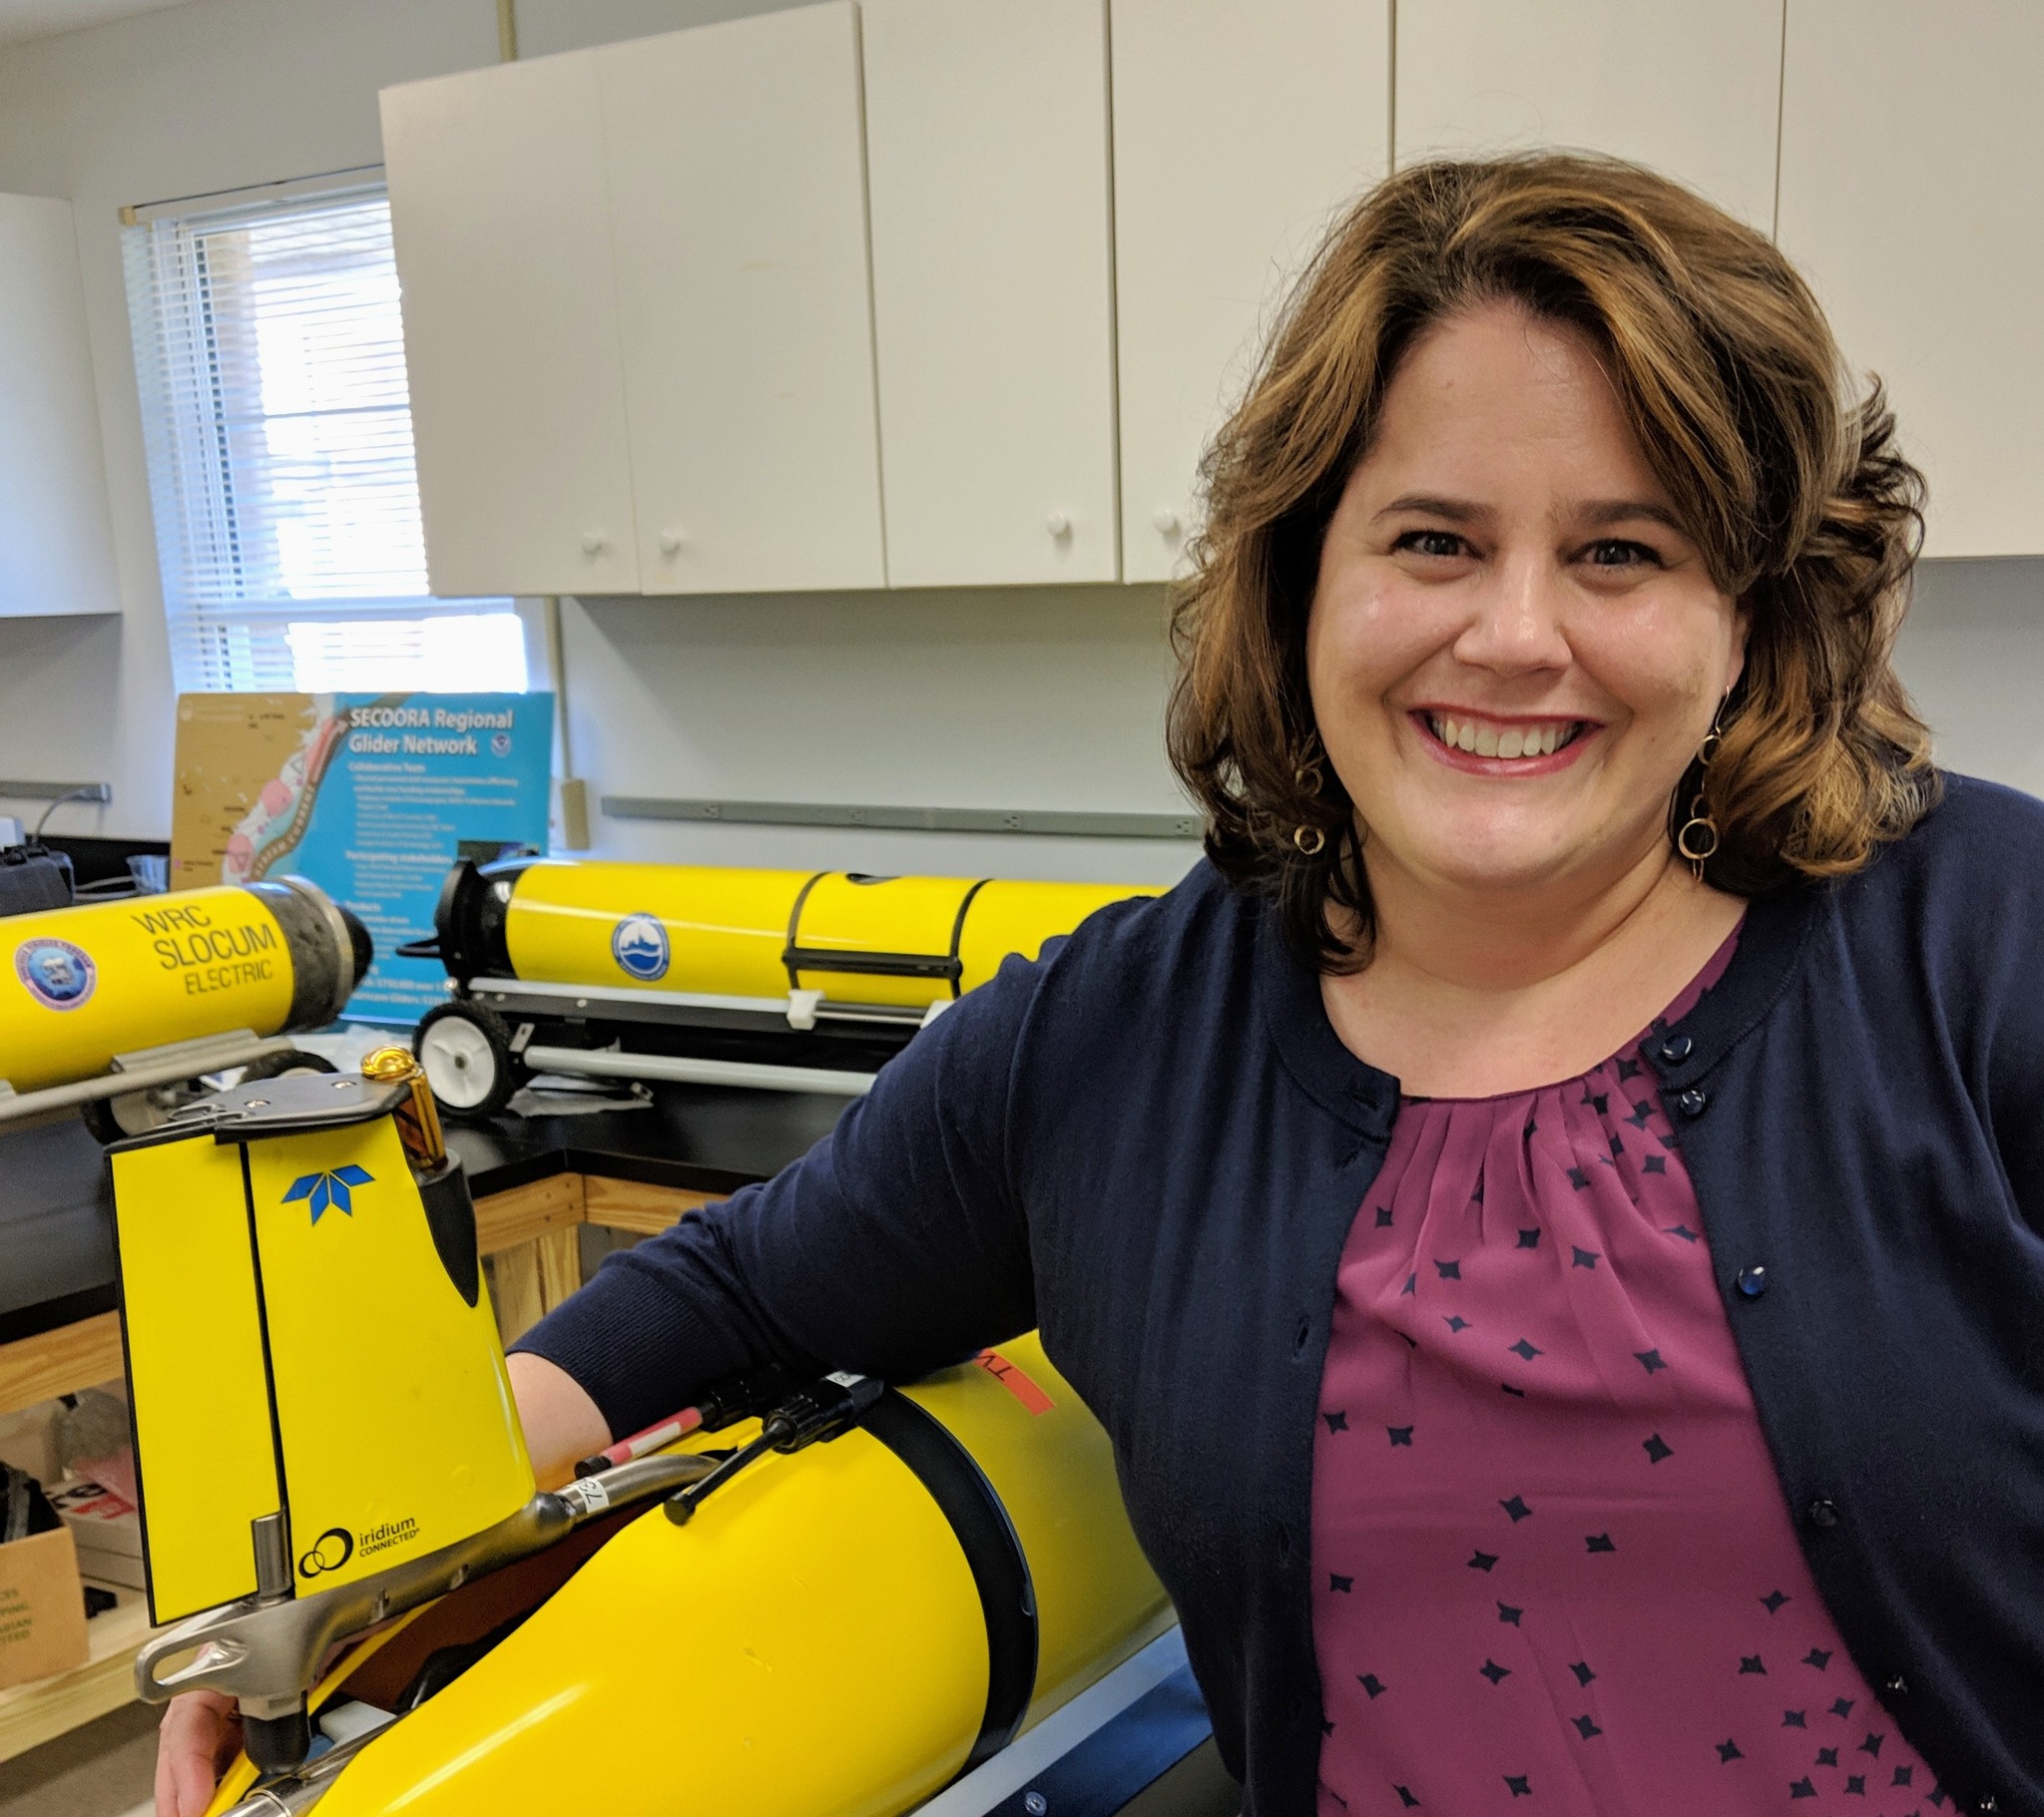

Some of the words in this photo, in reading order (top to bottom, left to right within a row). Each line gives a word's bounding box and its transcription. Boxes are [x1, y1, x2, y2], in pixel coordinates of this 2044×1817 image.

[350, 707, 430, 727] SECOORA
[434, 708, 513, 733] Regional
[349, 734, 399, 754] Glider
[403, 735, 478, 755] Network
[131, 905, 211, 934] WRC
[154, 923, 277, 970] SLOCUM
[185, 960, 272, 996] ELECTRIC
[359, 1518, 416, 1547] iridium
